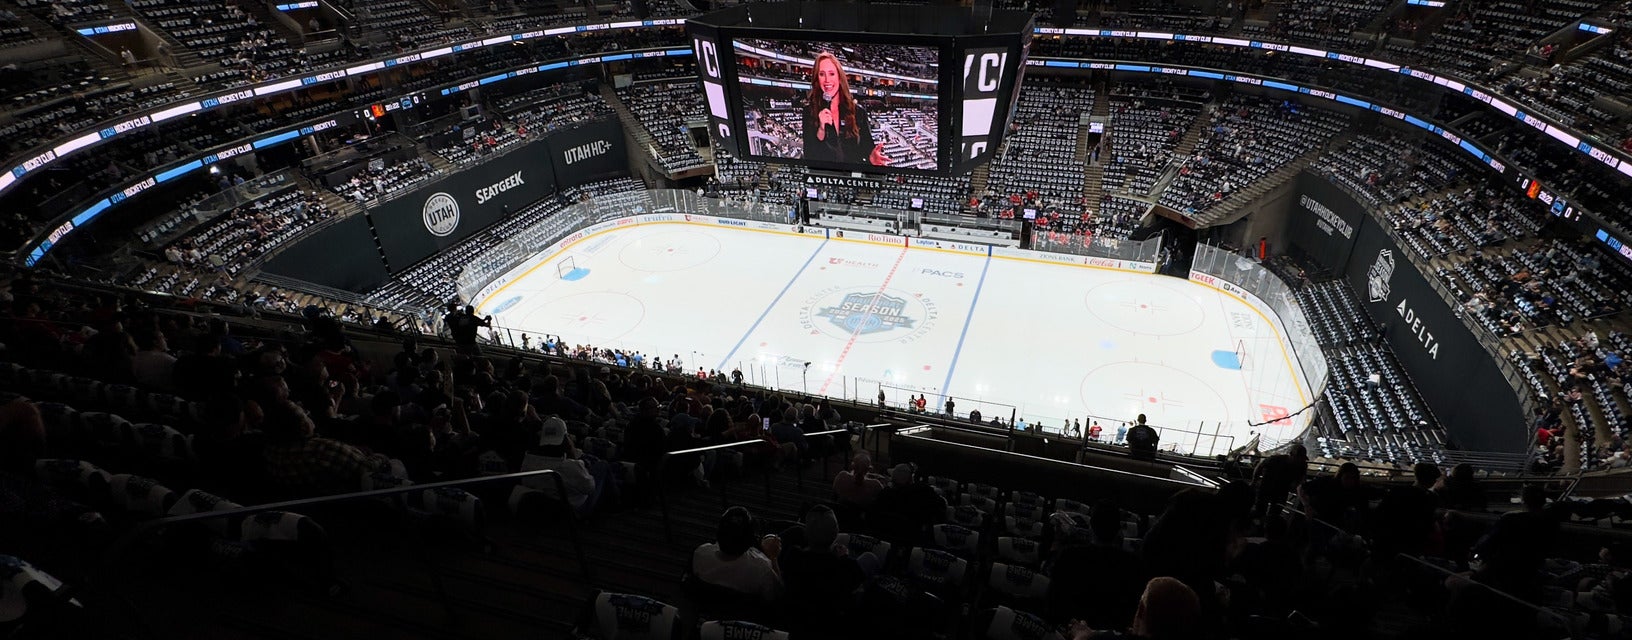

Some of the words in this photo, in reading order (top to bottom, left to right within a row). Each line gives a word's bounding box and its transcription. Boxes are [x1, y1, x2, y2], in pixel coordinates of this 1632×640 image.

[316, 72, 334, 82] HOCKEY
[334, 69, 346, 78] CLUB
[202, 97, 218, 108] UTAH
[217, 92, 239, 105] HOCKEY
[238, 89, 253, 100] CLUB
[363, 109, 371, 118] 0
[114, 119, 135, 134] HOCKEY
[134, 116, 151, 128] CLUB
[313, 121, 331, 132] HOCKEY
[203, 154, 218, 165] UTAH
[217, 147, 239, 161] HOCKEY
[238, 143, 253, 154] CLUB
[564, 144, 591, 165] UTAH
[591, 139, 612, 157] HC+
[475, 170, 525, 205] SEATGEEK
[815, 177, 844, 186] DELTA
[847, 178, 880, 188] CENTER
[1521, 178, 1529, 189] 0
[111, 191, 126, 204] UTAH
[124, 181, 144, 198] HOCKEY
[141, 177, 156, 190] CLUB
[428, 204, 455, 226] UTAH
[1300, 194, 1353, 239] @UTAHHOCKEYCLUB
[1564, 207, 1573, 218] 0
[560, 232, 583, 249] entrata
[868, 233, 882, 242] Rio
[881, 235, 902, 245] Tinto
[916, 239, 935, 247] Layton
[1607, 236, 1622, 251] UTAH
[958, 244, 985, 252] DELTA
[922, 268, 965, 279] PACS
[486, 278, 507, 295] DELTA
[841, 301, 904, 316] SEASON
[1404, 308, 1439, 360] DELTA
[616, 605, 650, 624] GAME
[725, 625, 761, 640] GAME
